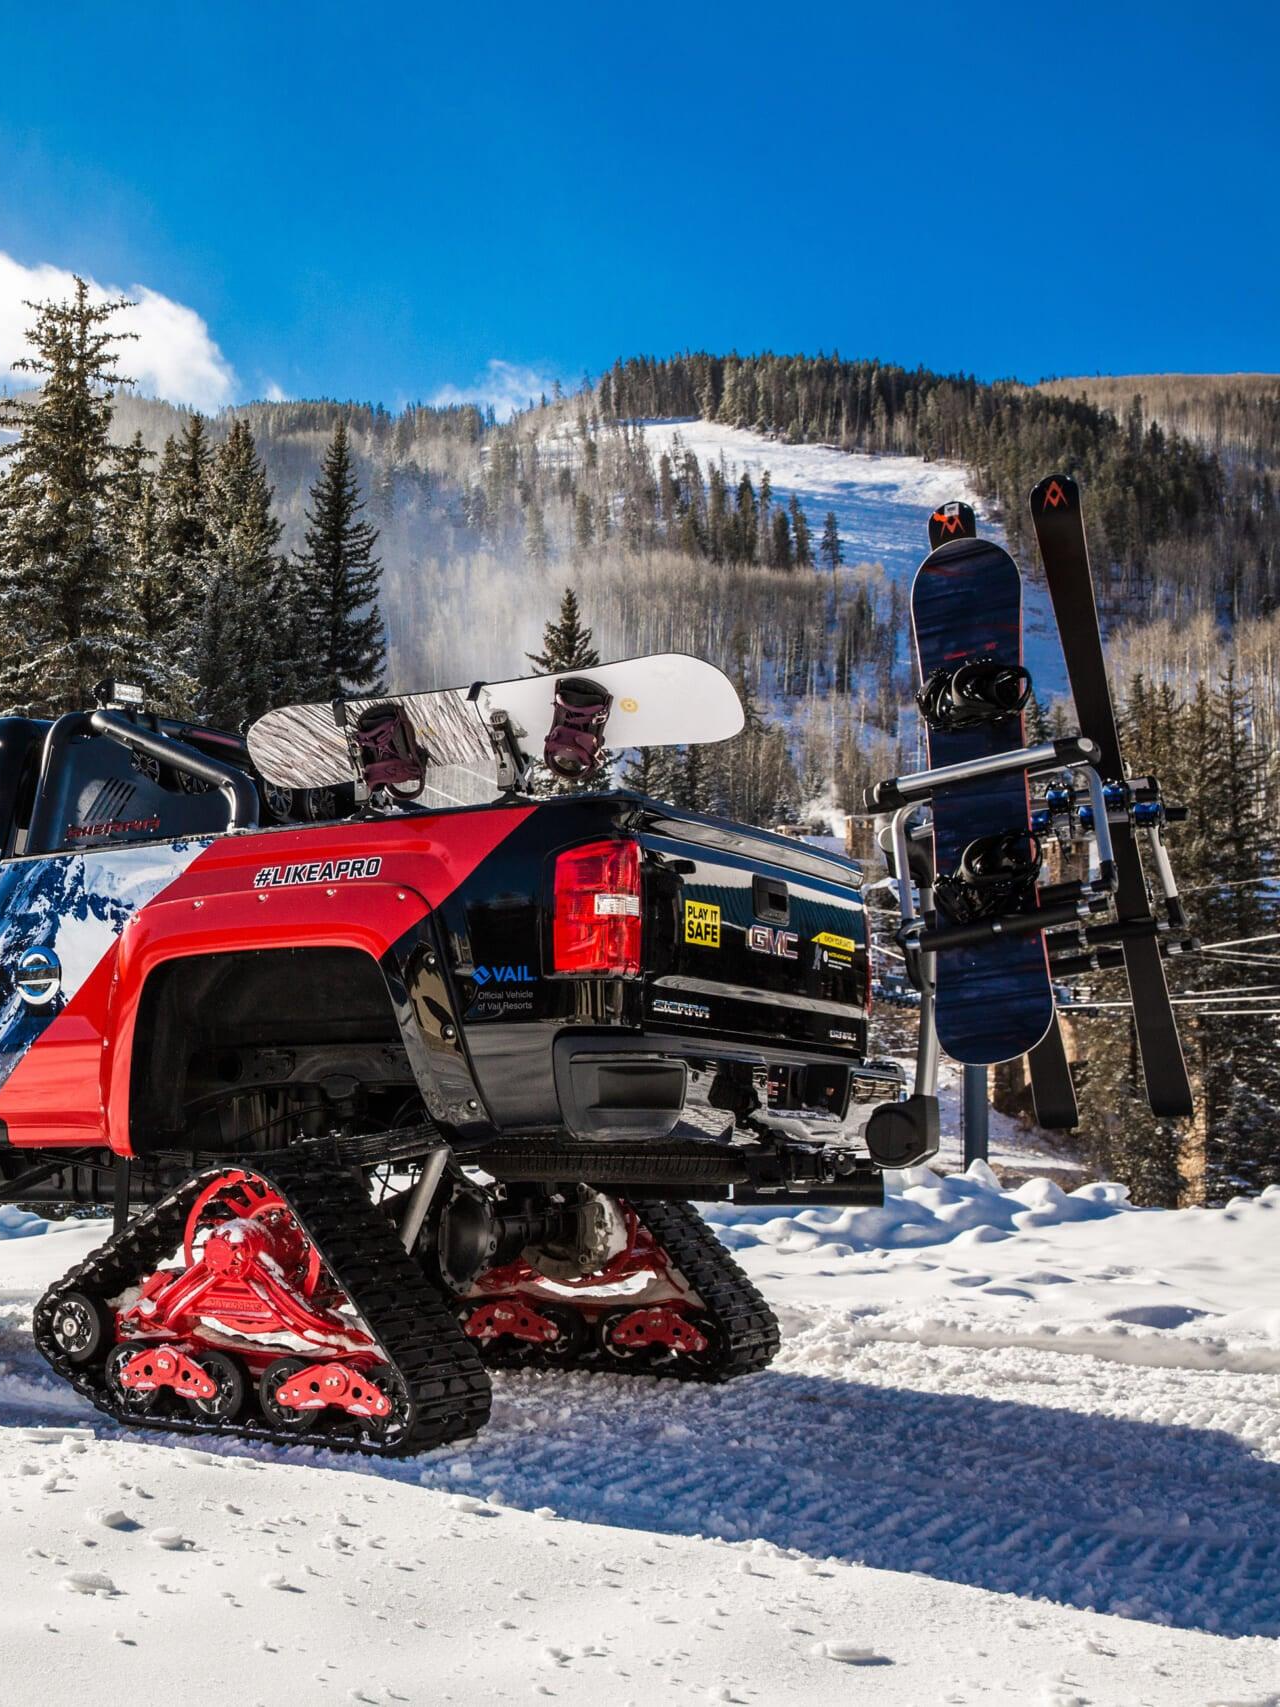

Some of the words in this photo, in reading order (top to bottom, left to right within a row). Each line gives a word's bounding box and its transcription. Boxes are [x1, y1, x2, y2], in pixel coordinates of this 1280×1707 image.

[254, 857, 382, 888] #LIKEAPRO
[687, 906, 709, 920] PLAY
[710, 910, 718, 921] IT
[687, 920, 718, 943] SAFE
[749, 925, 799, 959] GMC
[492, 965, 533, 982] VAIL
[478, 991, 504, 1000] Official
[506, 990, 534, 999] Vehicle
[478, 1003, 486, 1011] of
[487, 1002, 501, 1010] Vail
[503, 1002, 533, 1010] Resorts
[653, 999, 710, 1018] SIERRA
